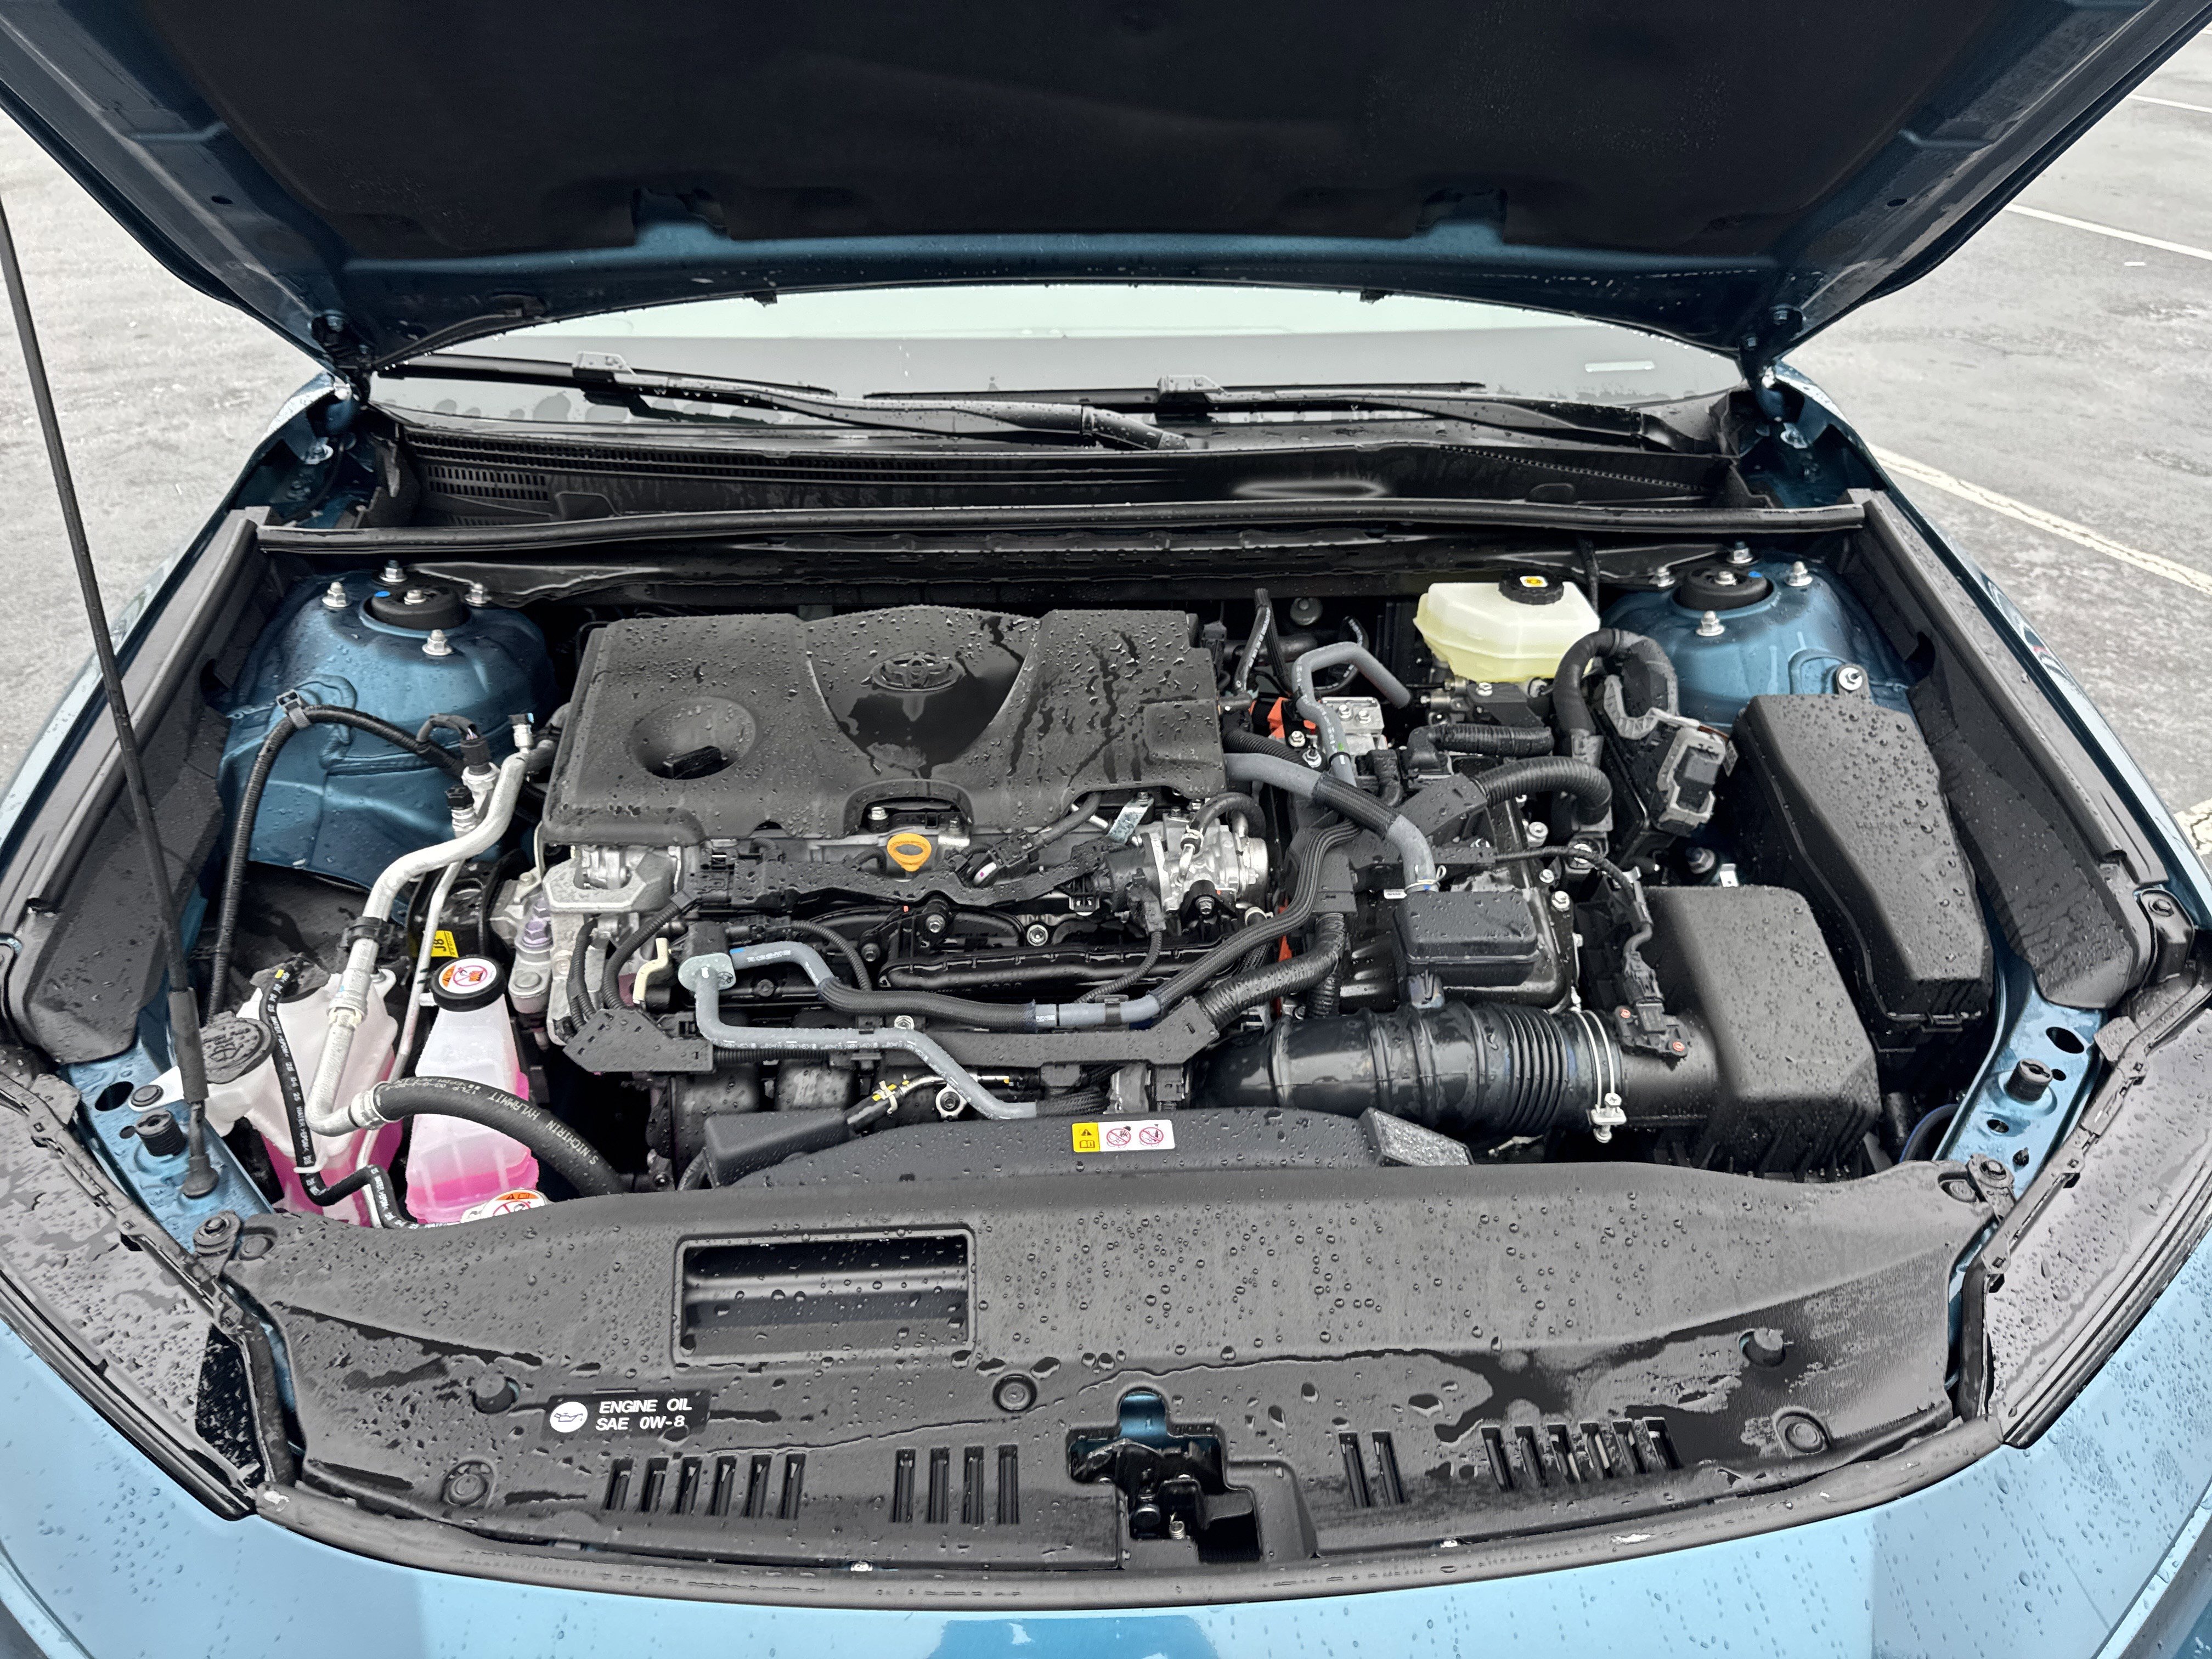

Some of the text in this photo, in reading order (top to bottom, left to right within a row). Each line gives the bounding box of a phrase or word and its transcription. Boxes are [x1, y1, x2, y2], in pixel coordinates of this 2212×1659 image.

[296, 1105, 306, 1127] WATER
[546, 1120, 590, 1156] NICHIRIN
[599, 1398, 692, 1414] ENGINE OIL
[596, 1415, 685, 1431] SAE 0W-8
